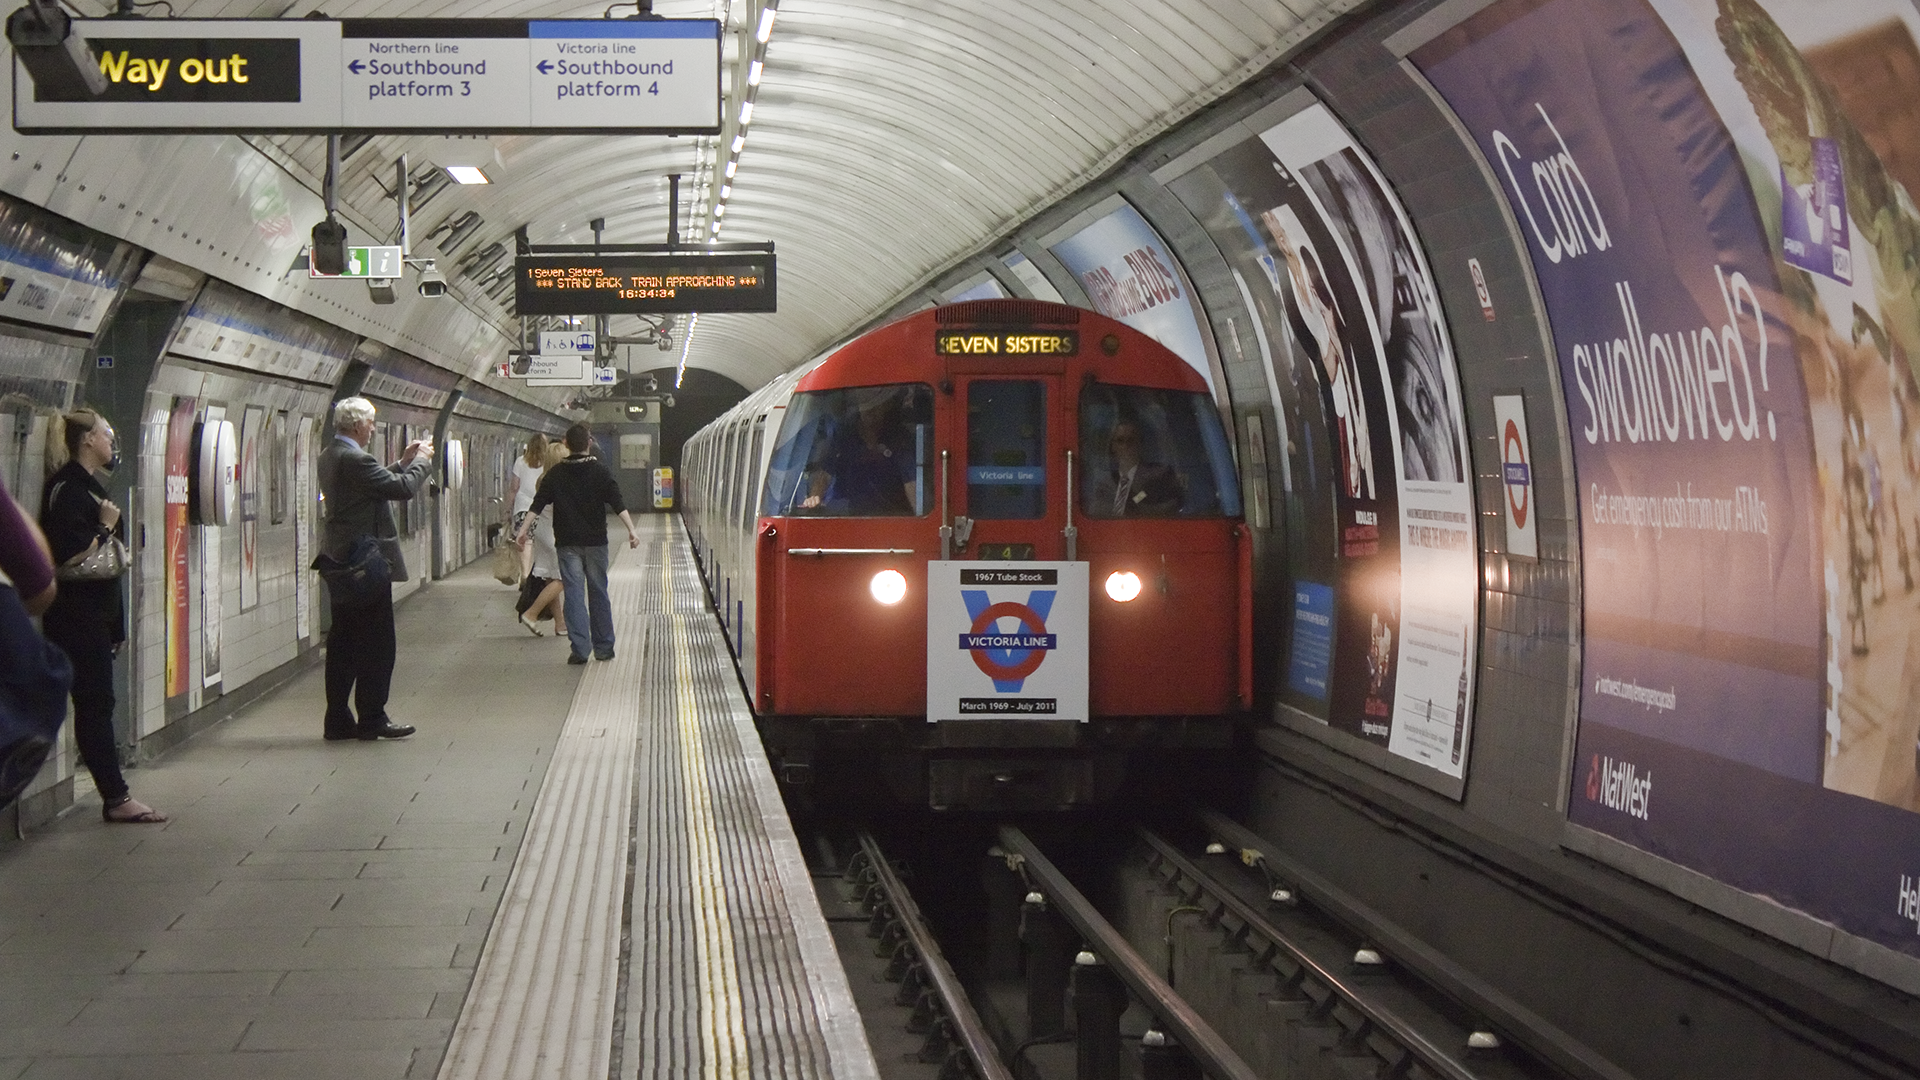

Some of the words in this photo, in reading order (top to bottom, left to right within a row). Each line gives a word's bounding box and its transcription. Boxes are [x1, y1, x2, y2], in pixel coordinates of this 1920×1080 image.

[369, 42, 431, 54] Northern
[435, 42, 459, 54] line
[557, 42, 608, 54] Victoria
[612, 42, 636, 54] line
[99, 51, 170, 91] Way
[179, 54, 249, 83] out
[369, 59, 487, 76] Southbound
[557, 59, 674, 76] Southbound
[369, 81, 453, 100] platform
[460, 81, 471, 97] 3
[557, 81, 641, 100] platform
[647, 81, 659, 97] 4
[1492, 102, 1612, 264] Card
[535, 268, 565, 278] Seven
[568, 267, 604, 278] Sisters
[1123, 245, 1180, 308] BUDS
[557, 277, 592, 289] STAND
[595, 277, 622, 288] BACK
[631, 276, 663, 288] TRAIN
[666, 276, 736, 287] APPROACHING
[618, 288, 676, 299] 16:34:34
[940, 336, 998, 354] SEVEN
[1005, 336, 1072, 354] SISTERS
[1573, 264, 1777, 444] swallowed?
[979, 471, 1014, 480] Victoria
[1018, 471, 1034, 480] line
[1591, 482, 1610, 524] Get
[1609, 495, 1663, 541] emergency
[1662, 481, 1686, 528] cash
[1686, 481, 1714, 530] from
[1714, 498, 1732, 531] our
[1735, 486, 1769, 535] ATMs
[974, 573, 995, 582] 1967
[996, 573, 1018, 582] Tube
[1019, 573, 1043, 582] Stock
[968, 637, 1021, 647] VICTORIA
[1024, 637, 1048, 647] LINE
[961, 702, 987, 711] March
[989, 702, 1009, 711] 1969
[1016, 702, 1034, 712] July
[1036, 702, 1056, 711] 2011
[1600, 756, 1652, 821] NatWest
